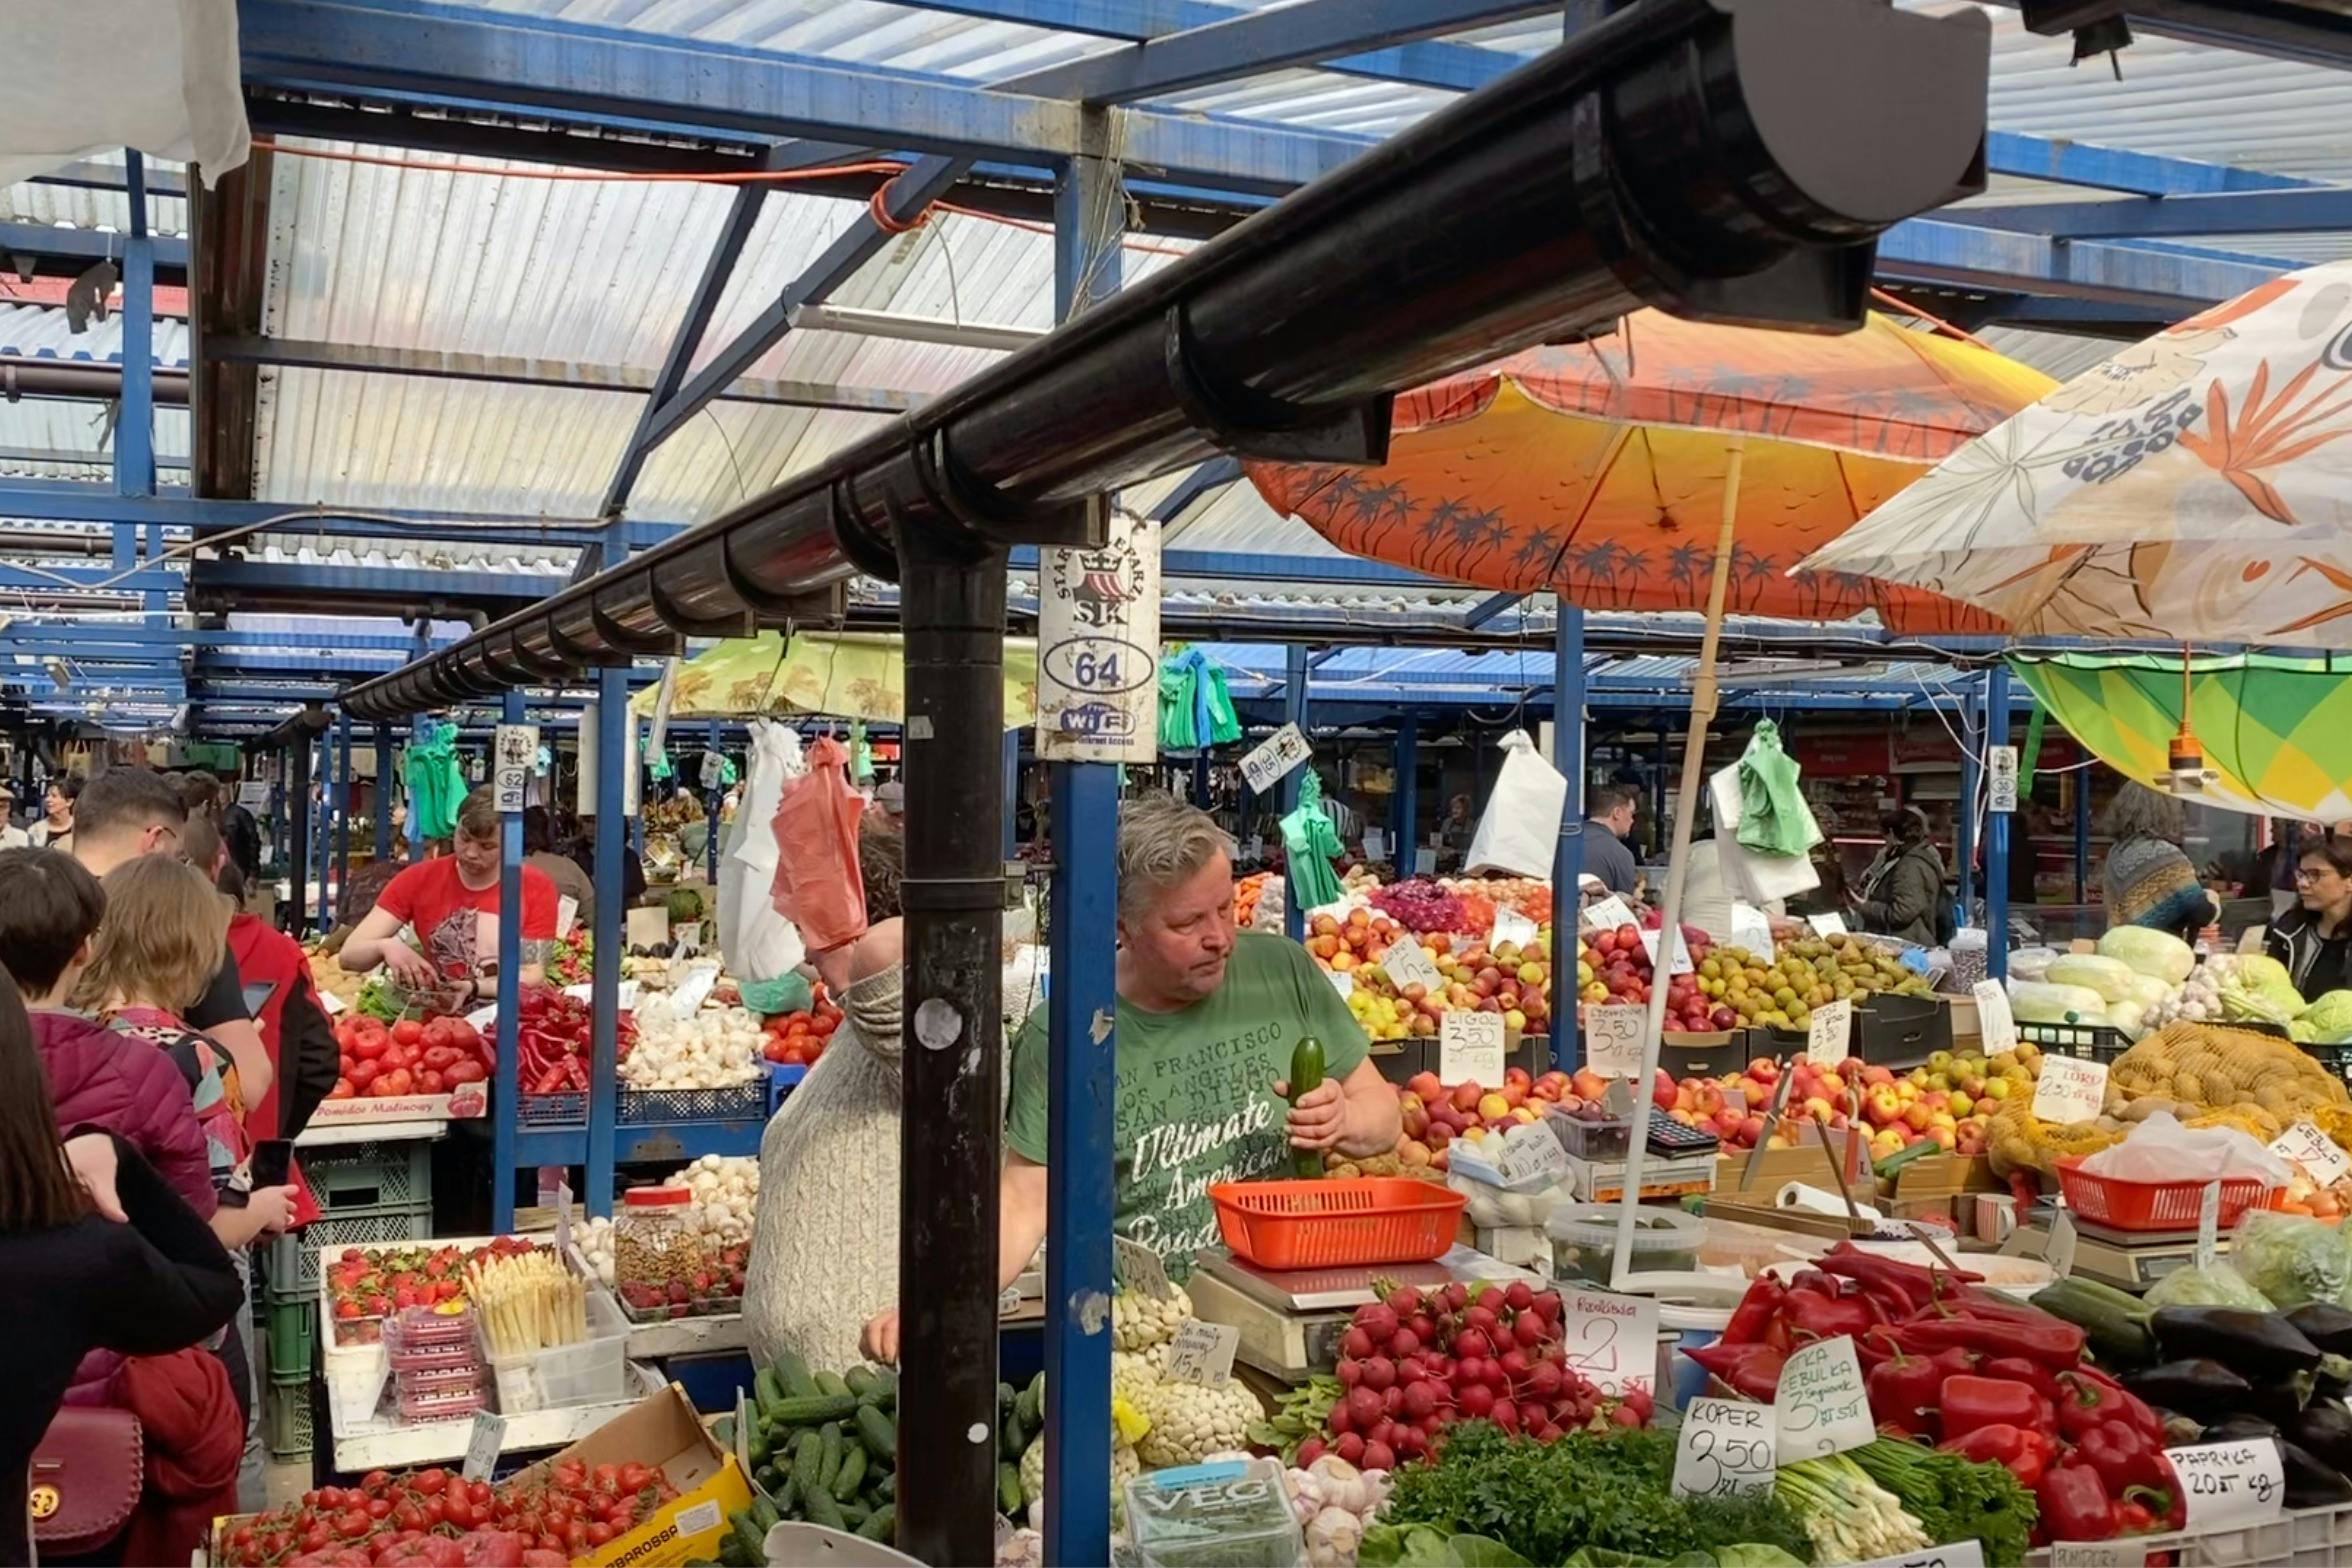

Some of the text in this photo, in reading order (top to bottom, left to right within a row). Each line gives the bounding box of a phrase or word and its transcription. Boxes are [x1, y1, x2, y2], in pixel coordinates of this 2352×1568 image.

[1075, 652, 1120, 687] 64
[1154, 1021, 1282, 1081] FRANCISCO
[1131, 1091, 1275, 1184] Ultimate
[1576, 1316, 1619, 1373] 2
[1691, 1402, 1763, 1429] KOPER
[2170, 1448, 2257, 1469] PAPRYKA
